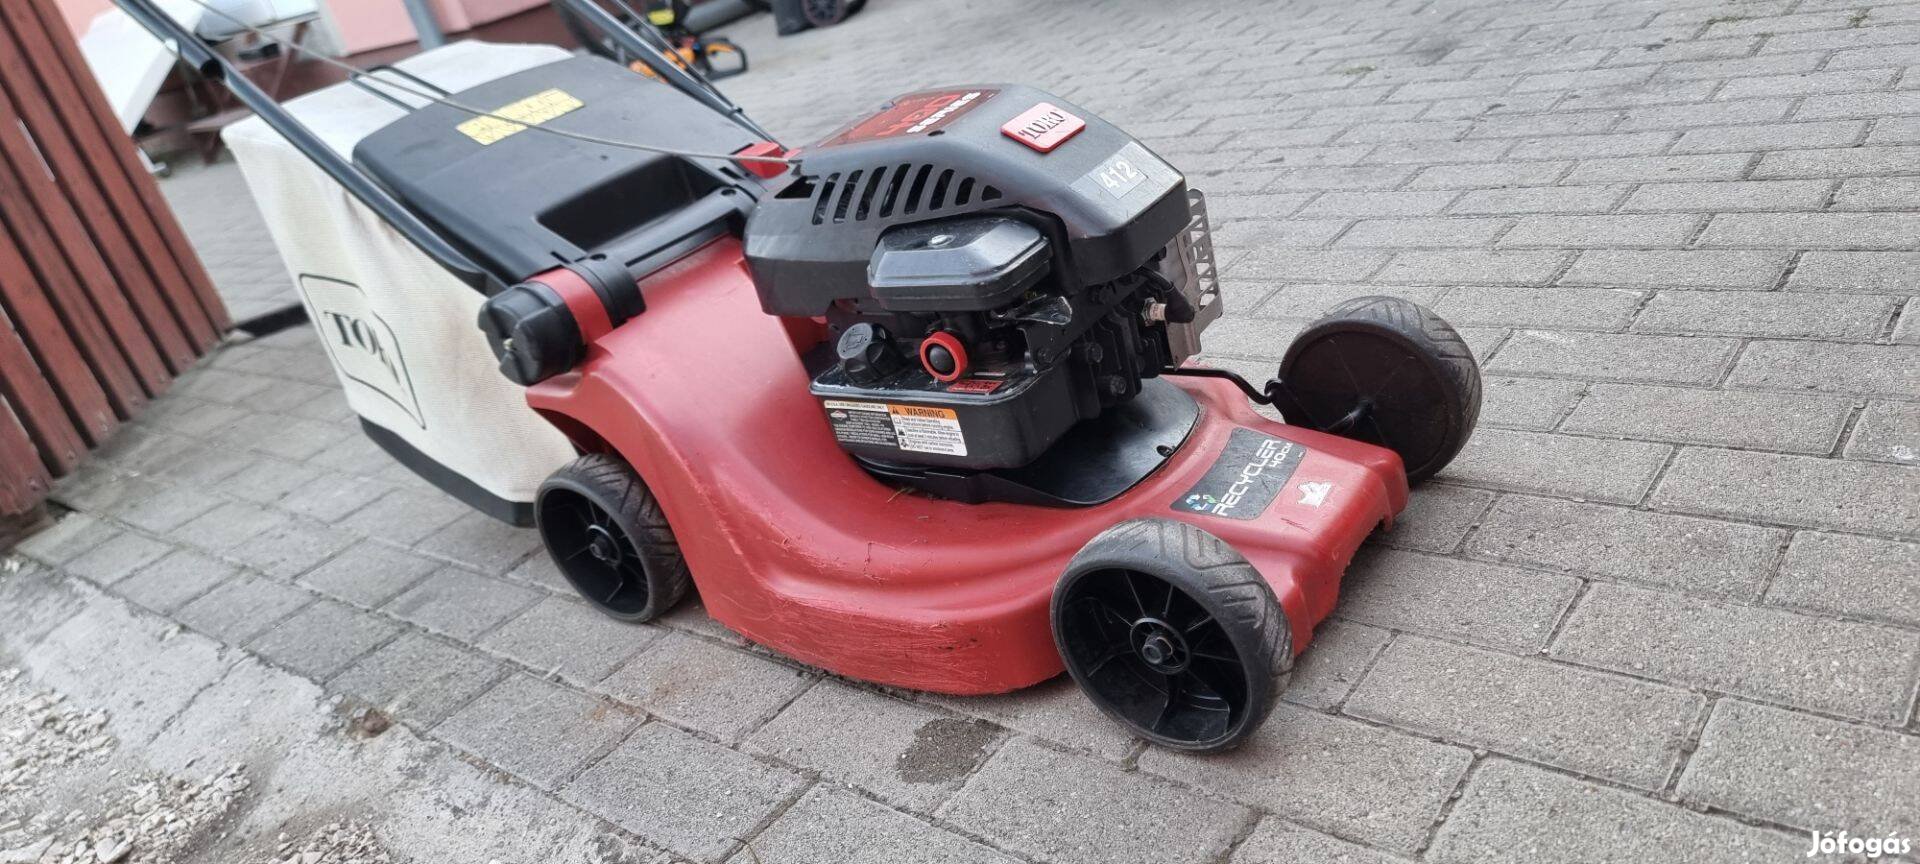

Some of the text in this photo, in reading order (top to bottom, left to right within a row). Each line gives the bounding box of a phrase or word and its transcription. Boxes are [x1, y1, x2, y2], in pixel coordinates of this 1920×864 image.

[1017, 110, 1066, 140] TORO
[1100, 160, 1138, 189] 412
[904, 407, 945, 419] WARNING
[1211, 438, 1281, 517] RECYCLER
